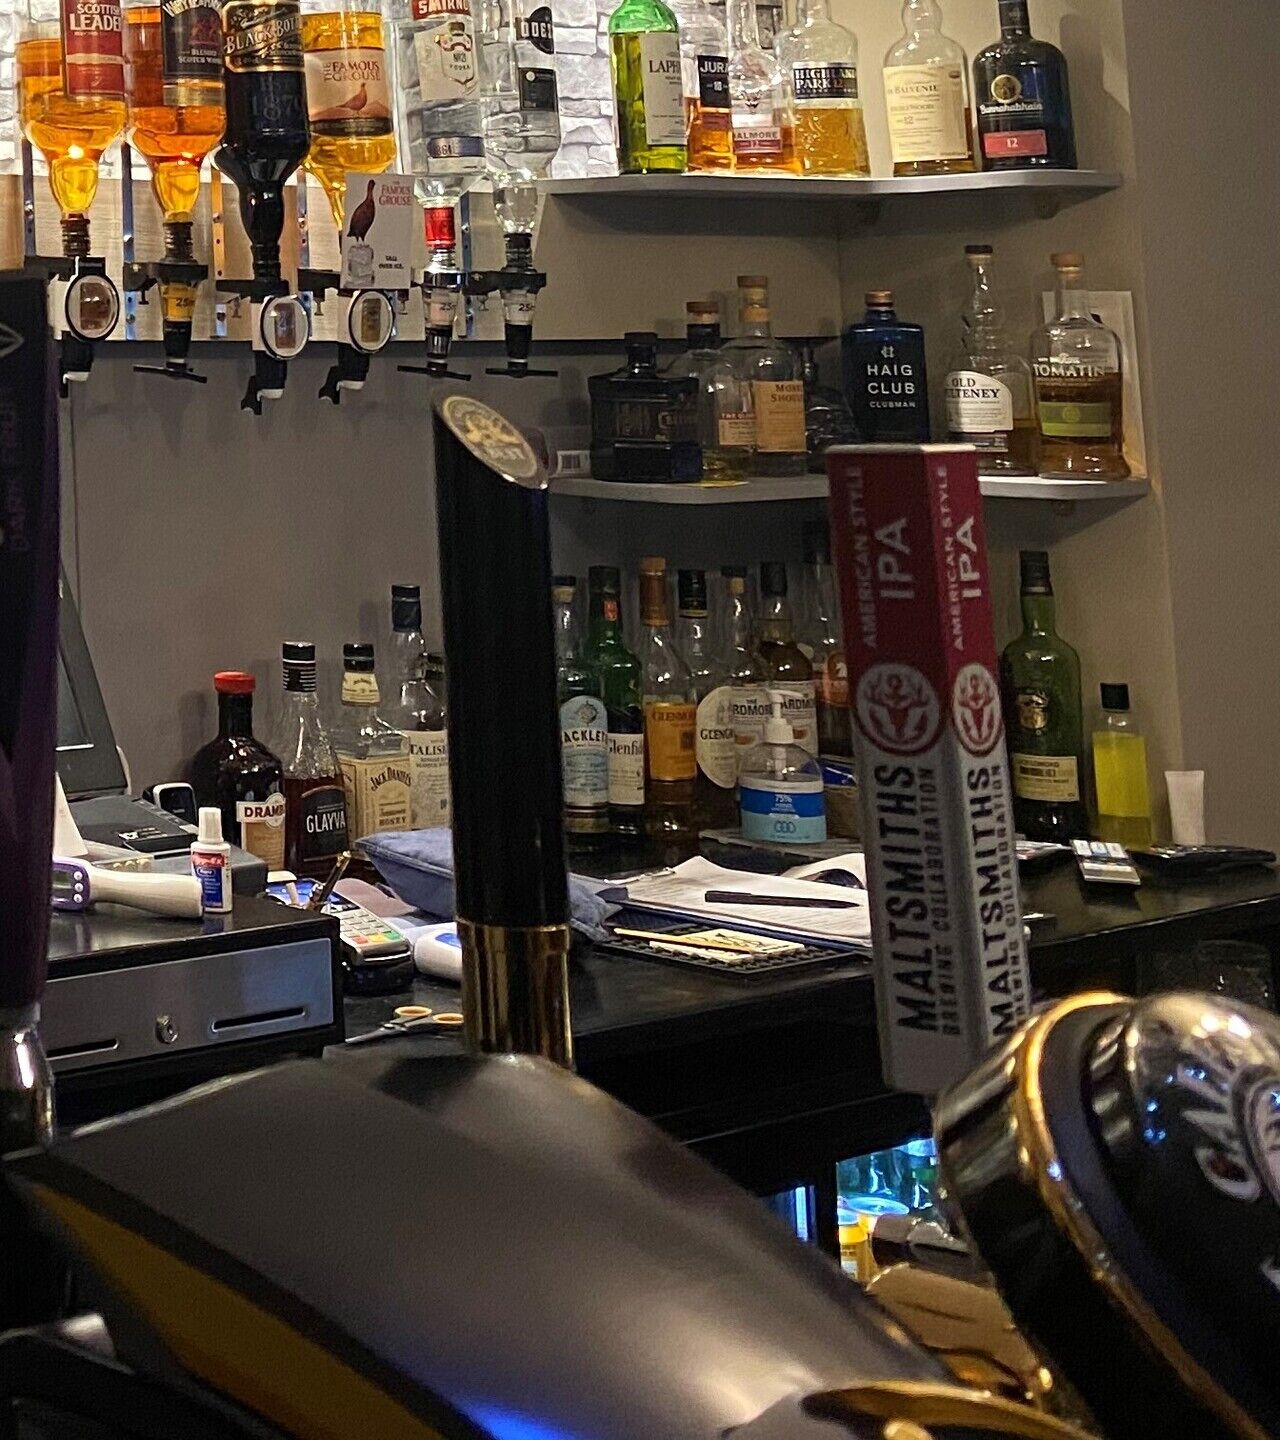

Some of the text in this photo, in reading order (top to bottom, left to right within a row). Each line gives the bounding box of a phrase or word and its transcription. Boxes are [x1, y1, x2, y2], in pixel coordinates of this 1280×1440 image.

[224, 23, 273, 54] BLACK
[332, 60, 380, 73] FAMOUS
[332, 71, 381, 83] GROUSE
[795, 78, 832, 90] PARK
[894, 84, 939, 95] BALVENIE
[1006, 137, 1019, 148] 12
[381, 184, 412, 195] FAMOUS
[378, 195, 412, 207] GROUSE
[867, 364, 913, 377] HAIG
[1032, 363, 1106, 378] TOMATIN
[867, 381, 915, 395] CLUB
[951, 377, 977, 388] OLD
[869, 400, 916, 409] CLUBMAN
[844, 465, 879, 650] AMERICAN STYLE
[874, 516, 916, 600] IPA
[937, 465, 965, 652] AMERICAN STYLE
[955, 515, 982, 600] IPA
[370, 774, 387, 792] JACK
[306, 810, 347, 834] GLAYVA
[990, 764, 1017, 928] COLLABORATION
[873, 764, 938, 1032] MALTSMITHS
[918, 766, 961, 1036] BREWING COLLABORATION
[967, 766, 1018, 1037] MALTSMITHS
